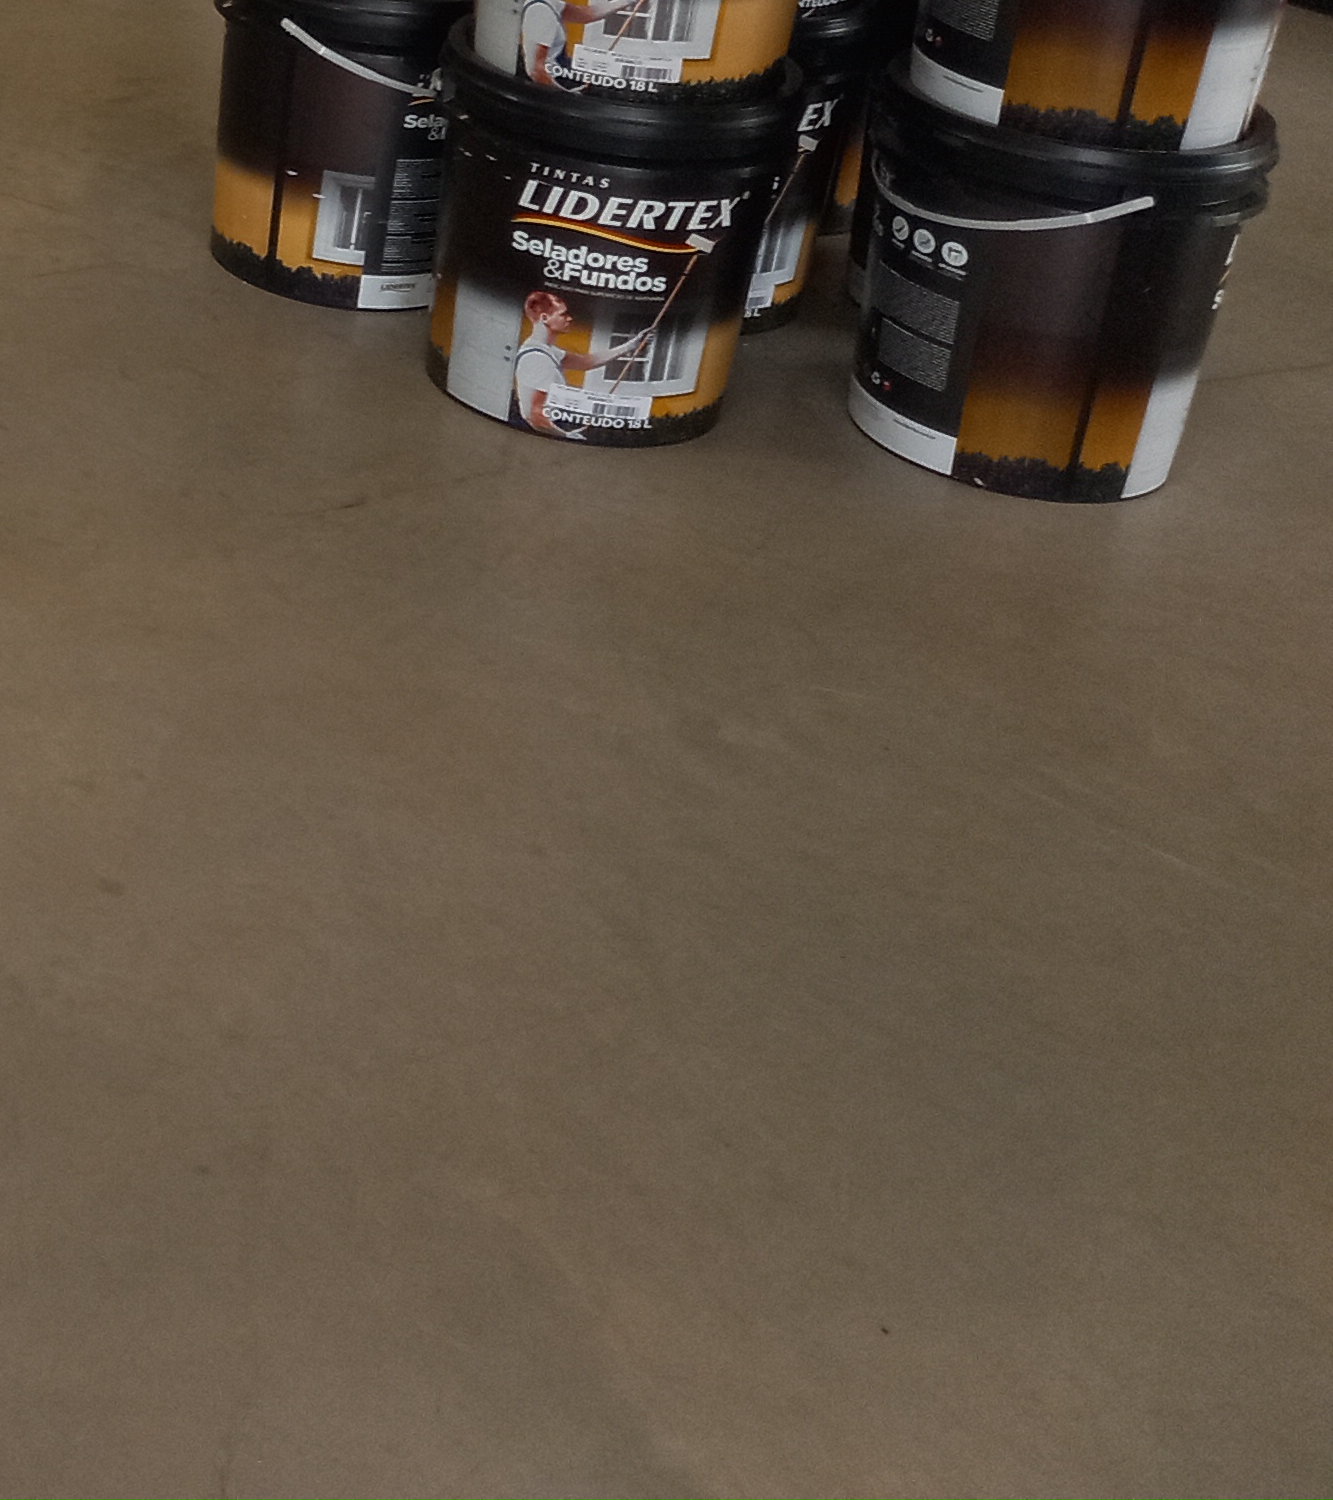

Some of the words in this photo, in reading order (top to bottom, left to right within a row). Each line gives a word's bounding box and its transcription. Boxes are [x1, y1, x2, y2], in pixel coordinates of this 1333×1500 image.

[630, 80, 646, 92] 18
[648, 81, 658, 93] L
[530, 161, 611, 189] TINTAS
[517, 179, 741, 231] LIDERTEX
[511, 230, 648, 273] Seladores
[543, 258, 667, 293] &Fundos
[627, 419, 642, 429] 18
[643, 418, 653, 429] L
